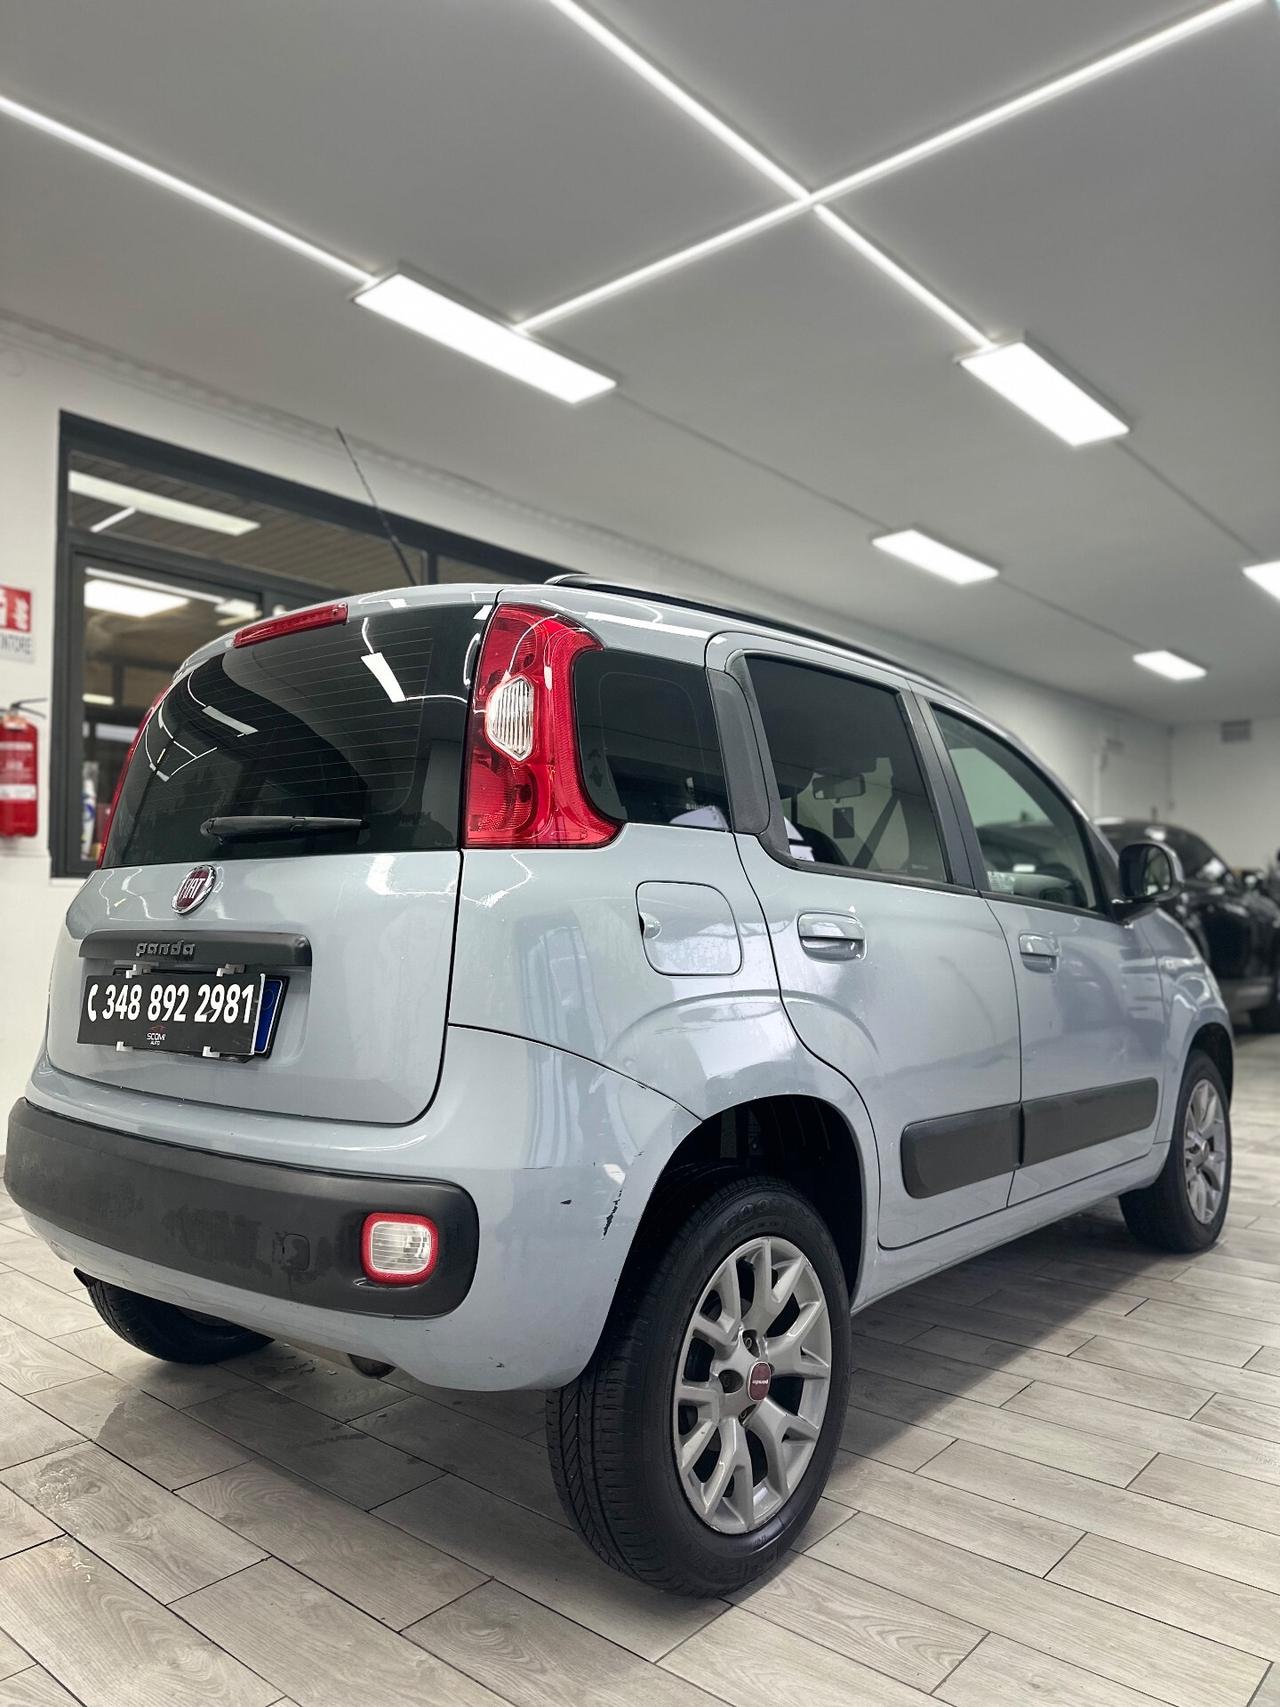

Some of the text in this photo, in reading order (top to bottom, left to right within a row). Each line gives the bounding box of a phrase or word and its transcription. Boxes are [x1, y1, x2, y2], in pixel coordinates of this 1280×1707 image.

[178, 877, 207, 902] FIAT
[135, 940, 196, 957] panda
[102, 984, 255, 1024] 348 892 2981
